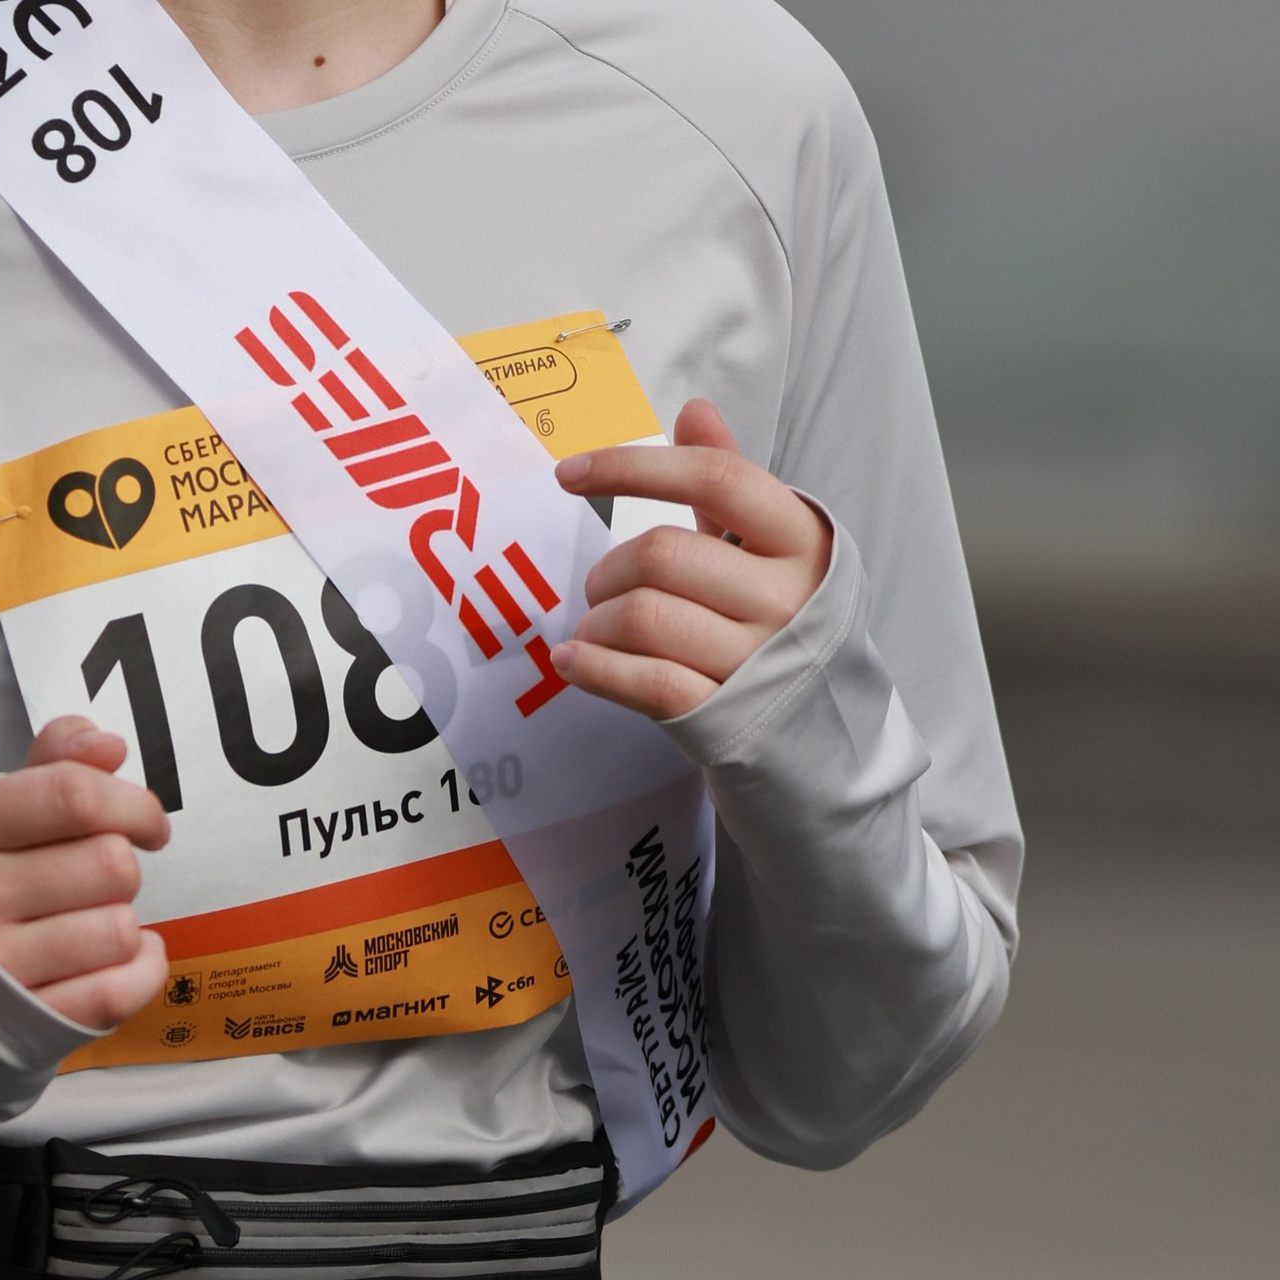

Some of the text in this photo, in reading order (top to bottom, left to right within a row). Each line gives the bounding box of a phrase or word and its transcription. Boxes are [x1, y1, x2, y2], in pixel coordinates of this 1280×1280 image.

[31, 63, 163, 184] 108
[179, 488, 274, 533] МАРА
[278, 790, 425, 859] Пульс
[364, 913, 460, 957] МОСКОВСКИЙ
[208, 961, 282, 981] Департамент
[208, 978, 246, 990] спорта
[364, 949, 410, 976] СПОРТ
[625, 824, 706, 1118] МОСКОВСКИЙ
[208, 982, 292, 1001] города Москвы
[252, 1021, 305, 1038] BRICS
[615, 933, 681, 1149] СБЕРПРАЙМ
